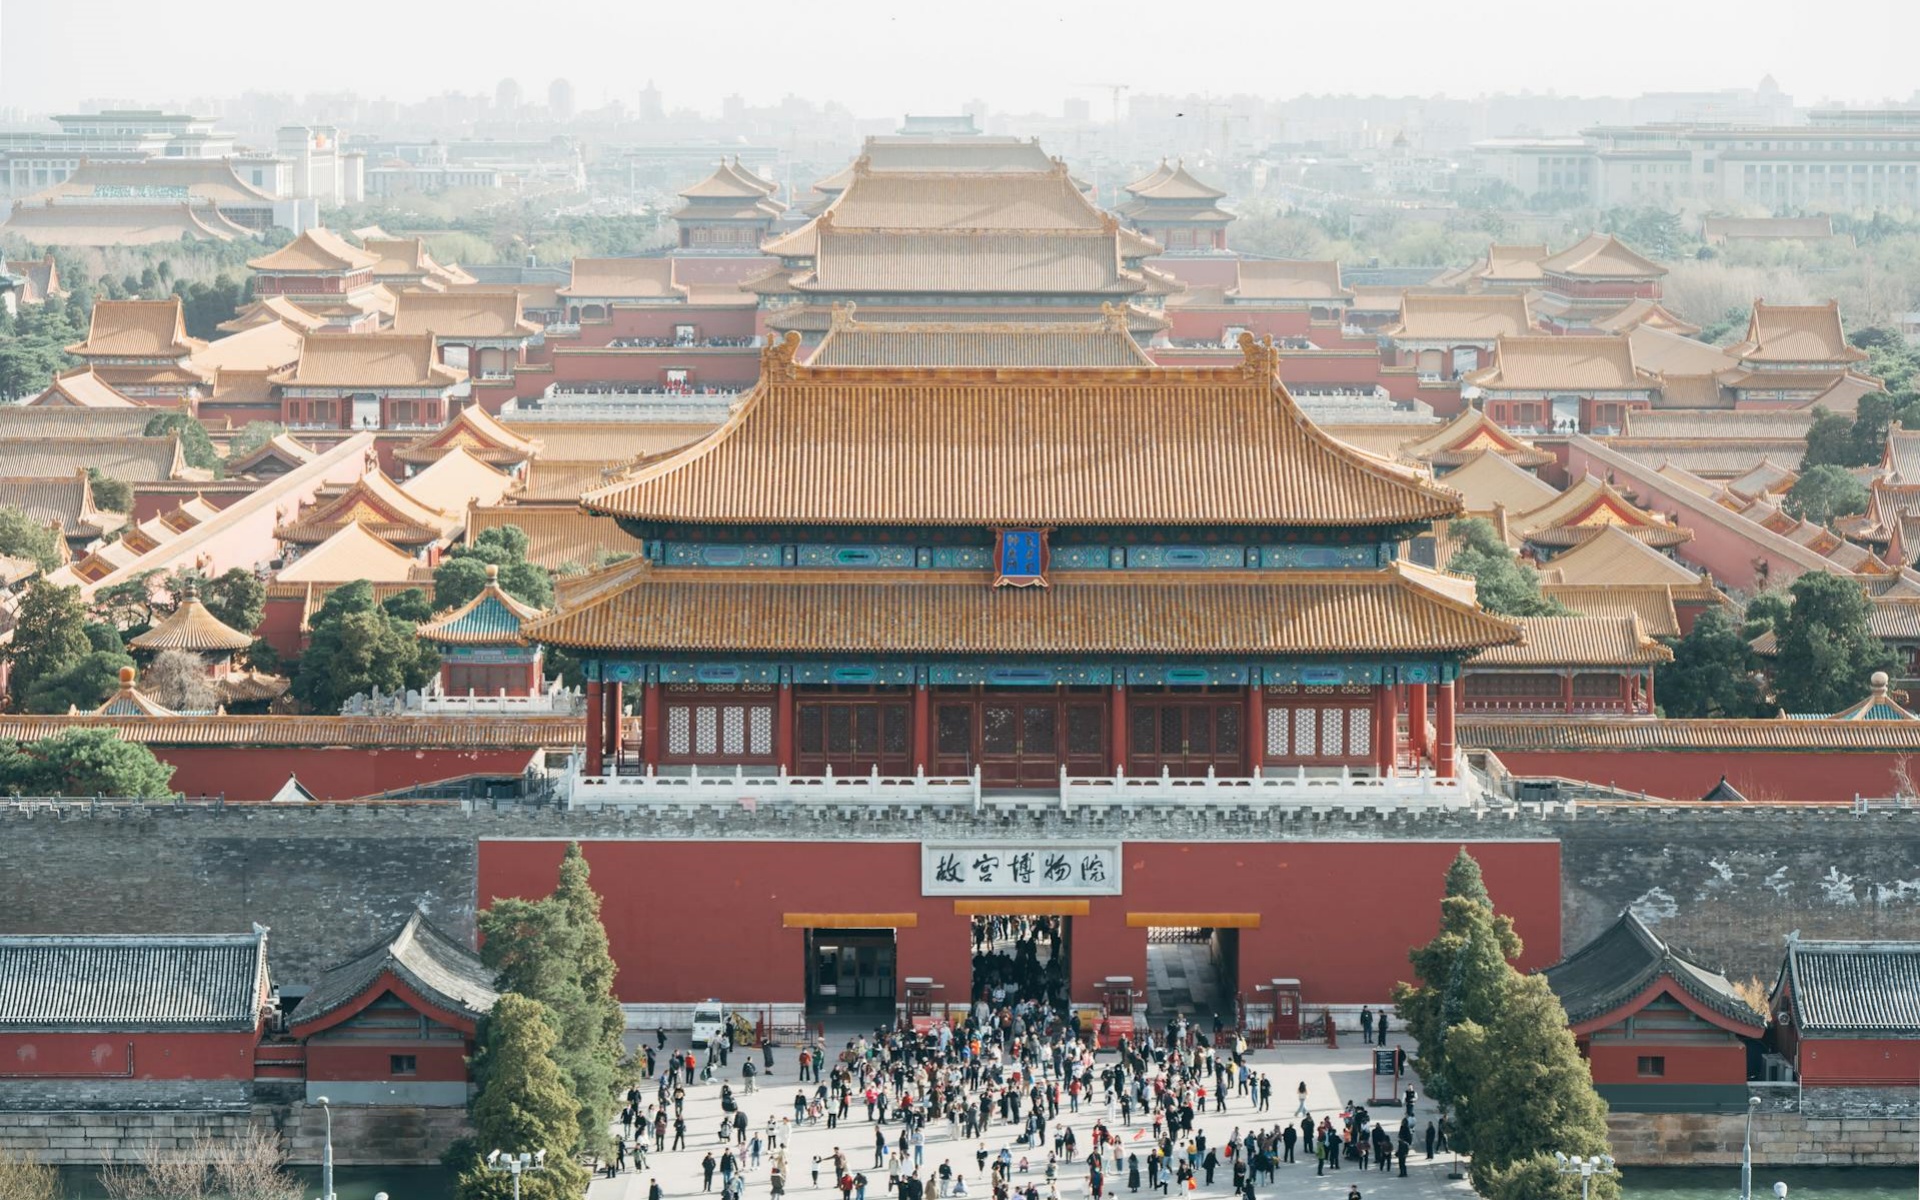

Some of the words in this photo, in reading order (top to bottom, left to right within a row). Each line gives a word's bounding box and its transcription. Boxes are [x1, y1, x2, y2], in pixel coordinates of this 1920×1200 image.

[935, 852, 1106, 883] 故宫博物院
